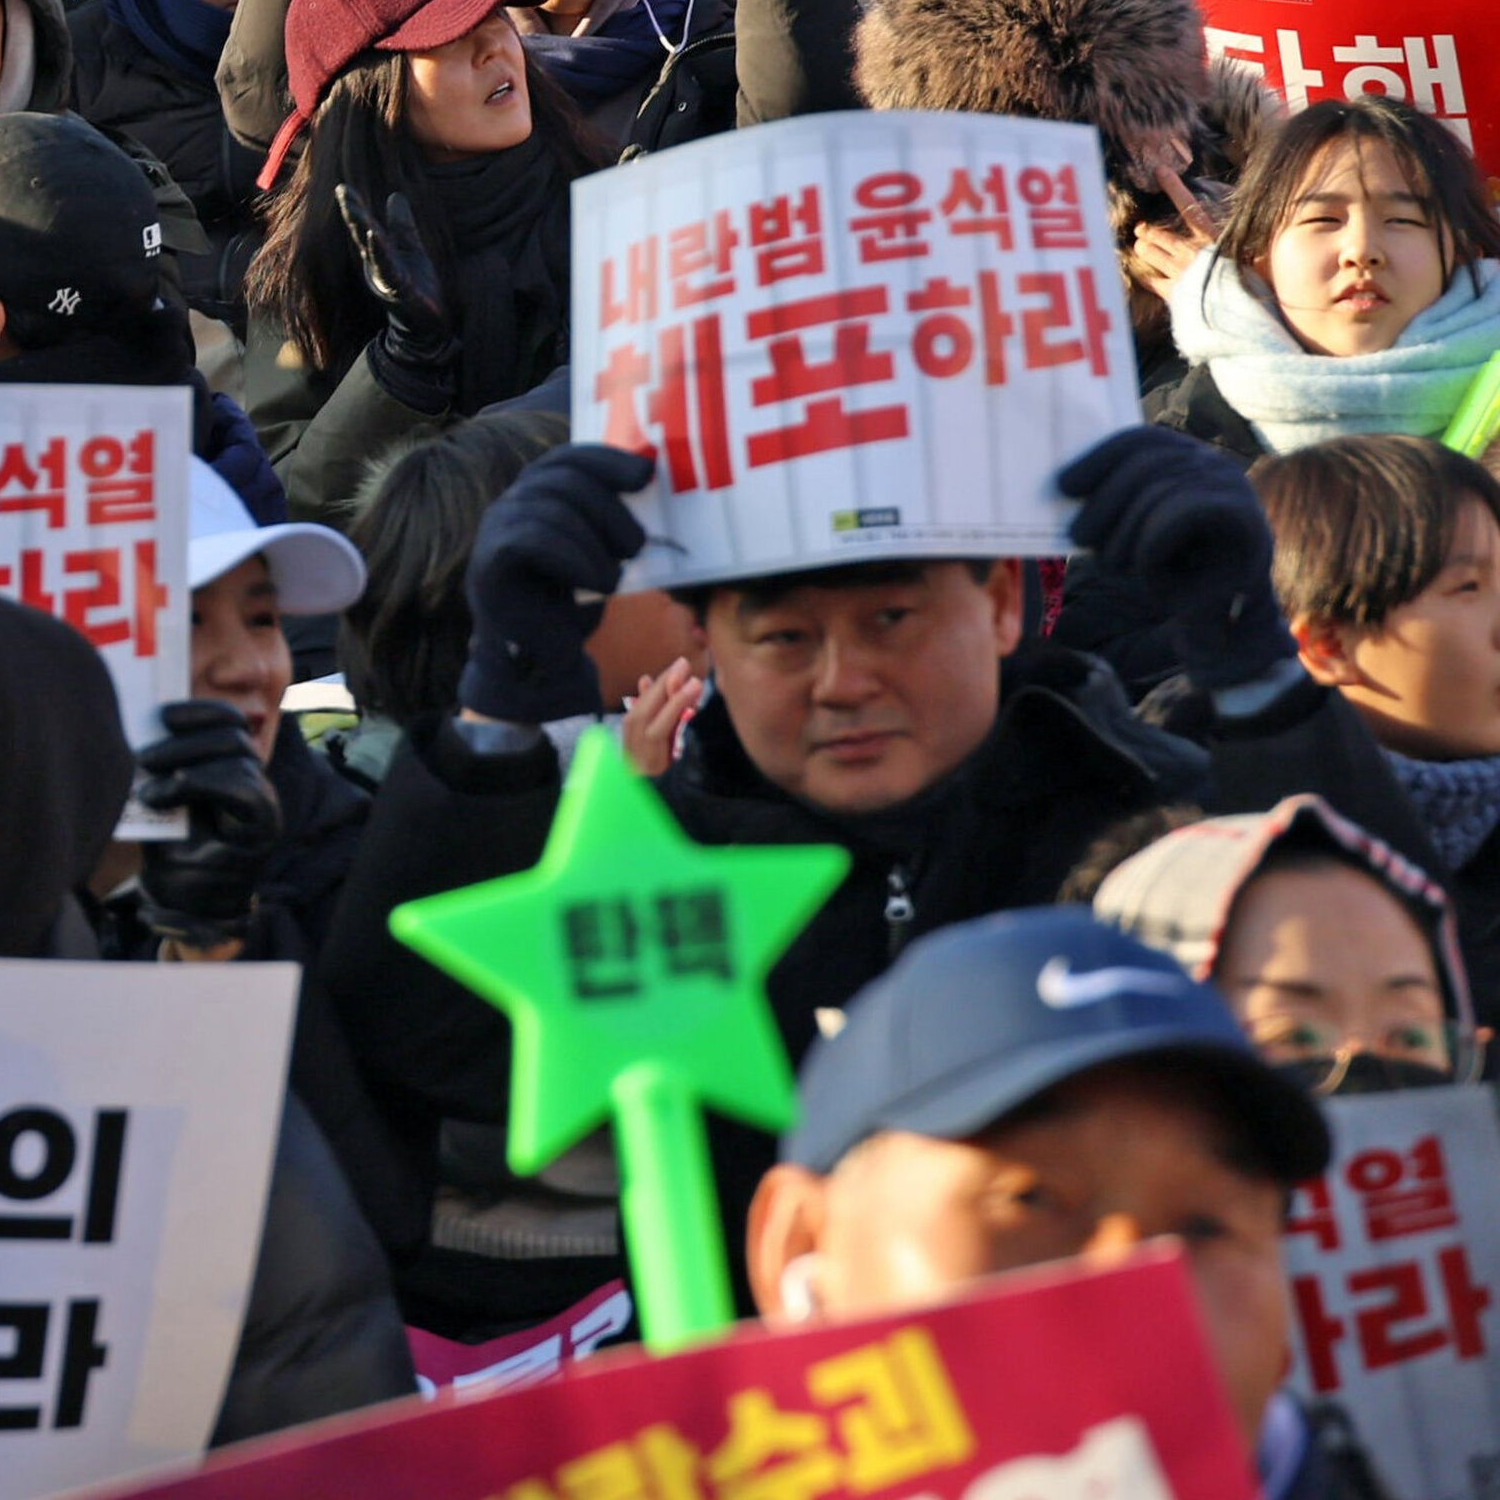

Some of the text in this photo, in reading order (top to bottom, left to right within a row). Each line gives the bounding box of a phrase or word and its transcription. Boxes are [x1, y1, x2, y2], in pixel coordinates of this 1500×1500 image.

[600, 164, 1089, 330] 내란범 윤석열
[594, 266, 1111, 494] 체포하라
